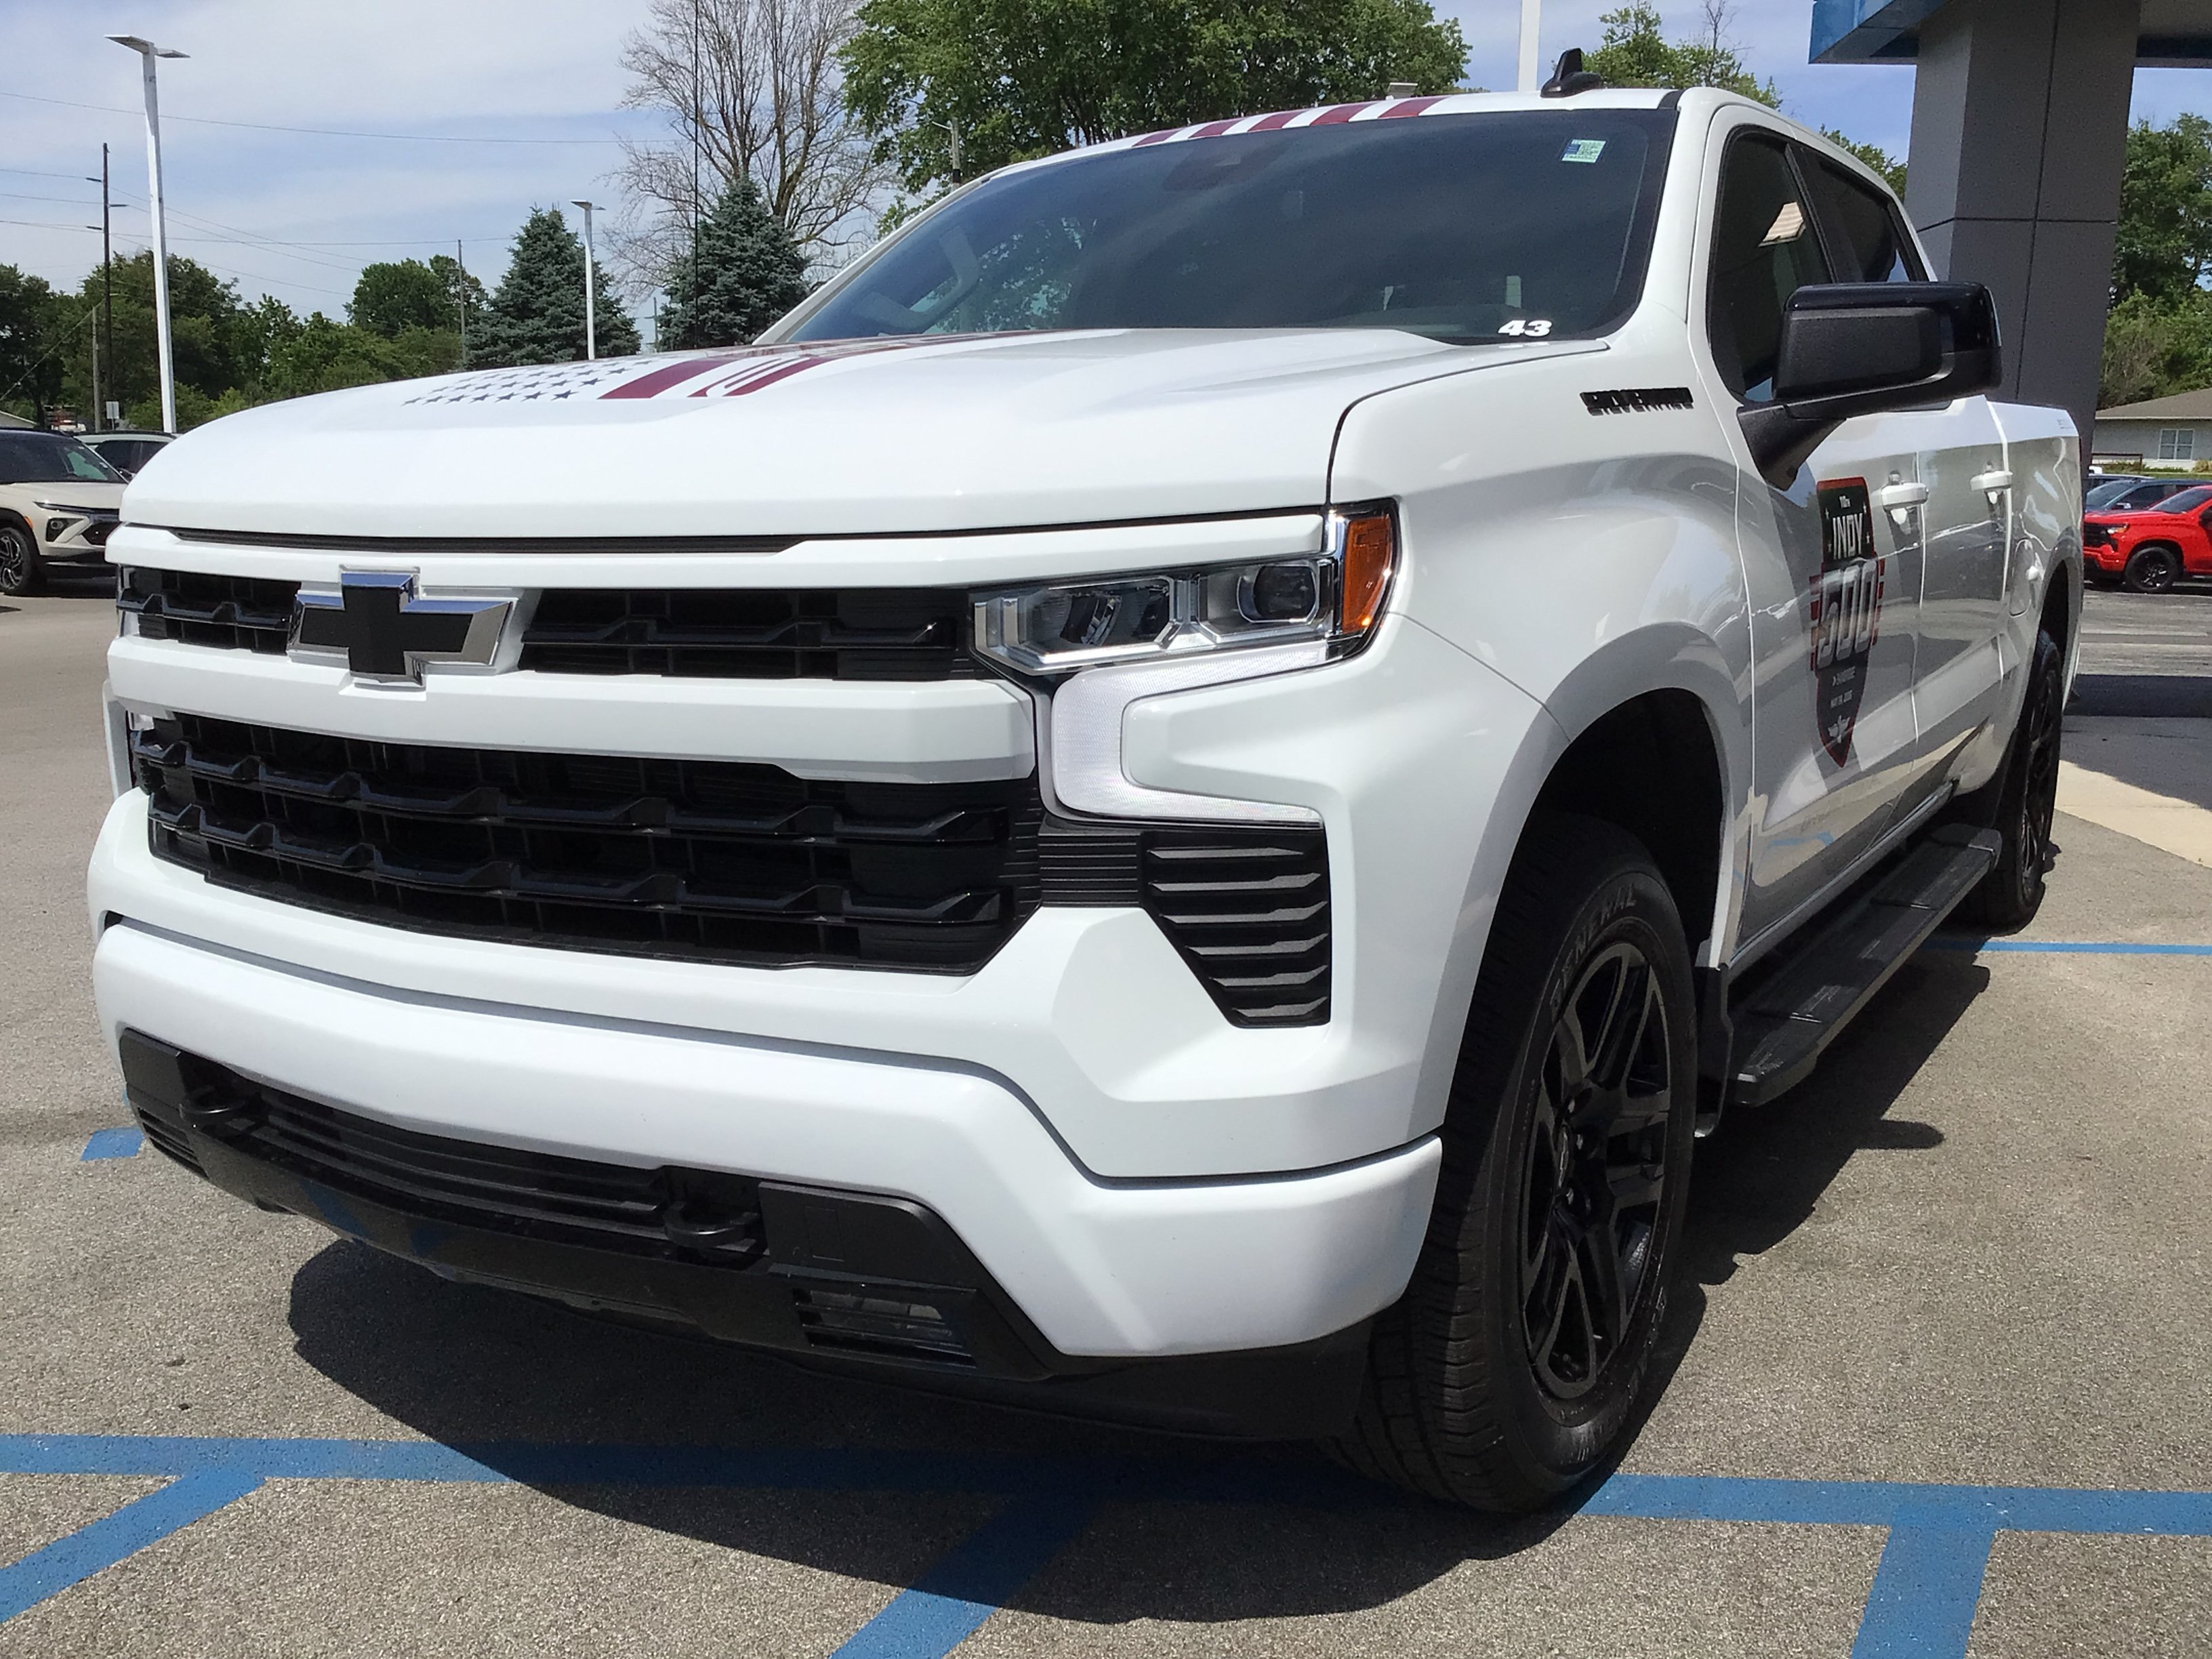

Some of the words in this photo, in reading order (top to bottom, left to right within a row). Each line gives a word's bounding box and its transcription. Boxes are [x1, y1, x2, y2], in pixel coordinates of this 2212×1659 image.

[1498, 319, 1553, 337] 43
[1832, 512, 1863, 560] INDY
[1817, 560, 1878, 669] 500
[1548, 882, 1637, 1024] GENERAL
